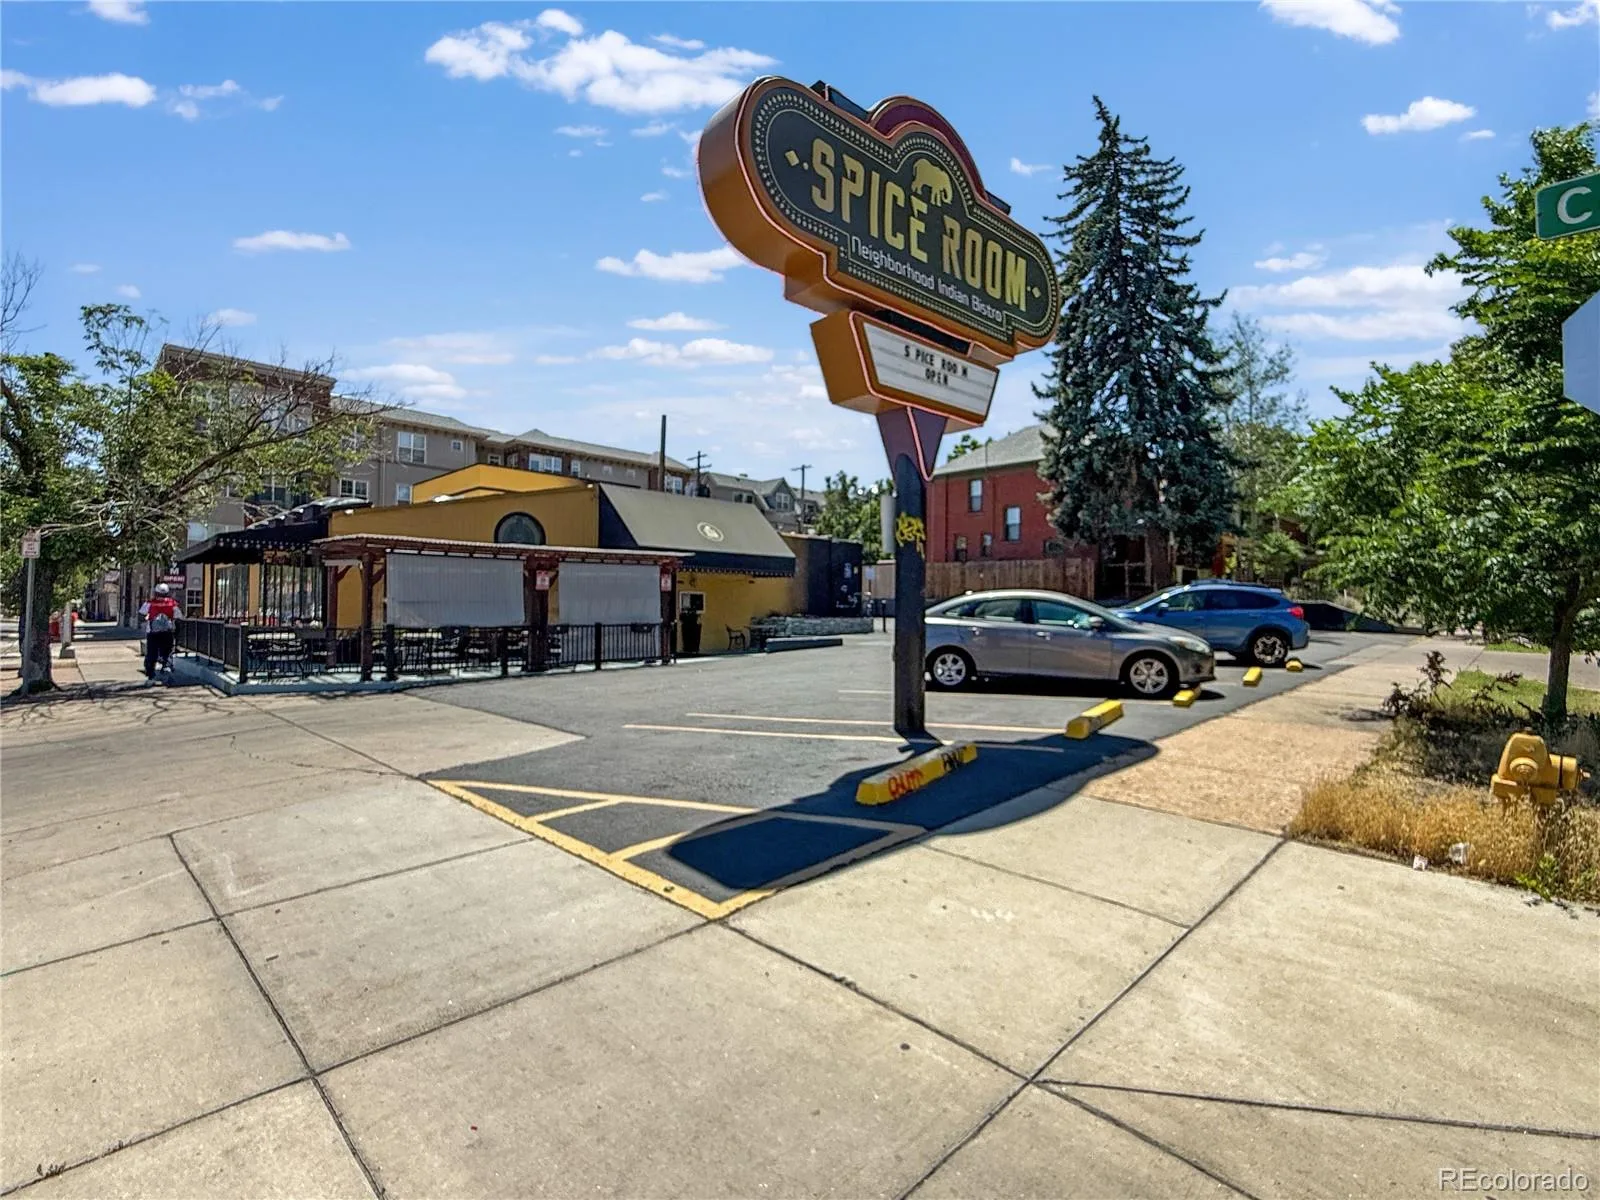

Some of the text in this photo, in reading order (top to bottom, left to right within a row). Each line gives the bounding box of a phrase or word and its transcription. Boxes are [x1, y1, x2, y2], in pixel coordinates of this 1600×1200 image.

[811, 138, 1027, 312] SPICE ROOM
[1557, 186, 1593, 225] C
[851, 236, 1002, 322] Neighborhood Indian Bistro
[925, 368, 948, 385] OPEN
